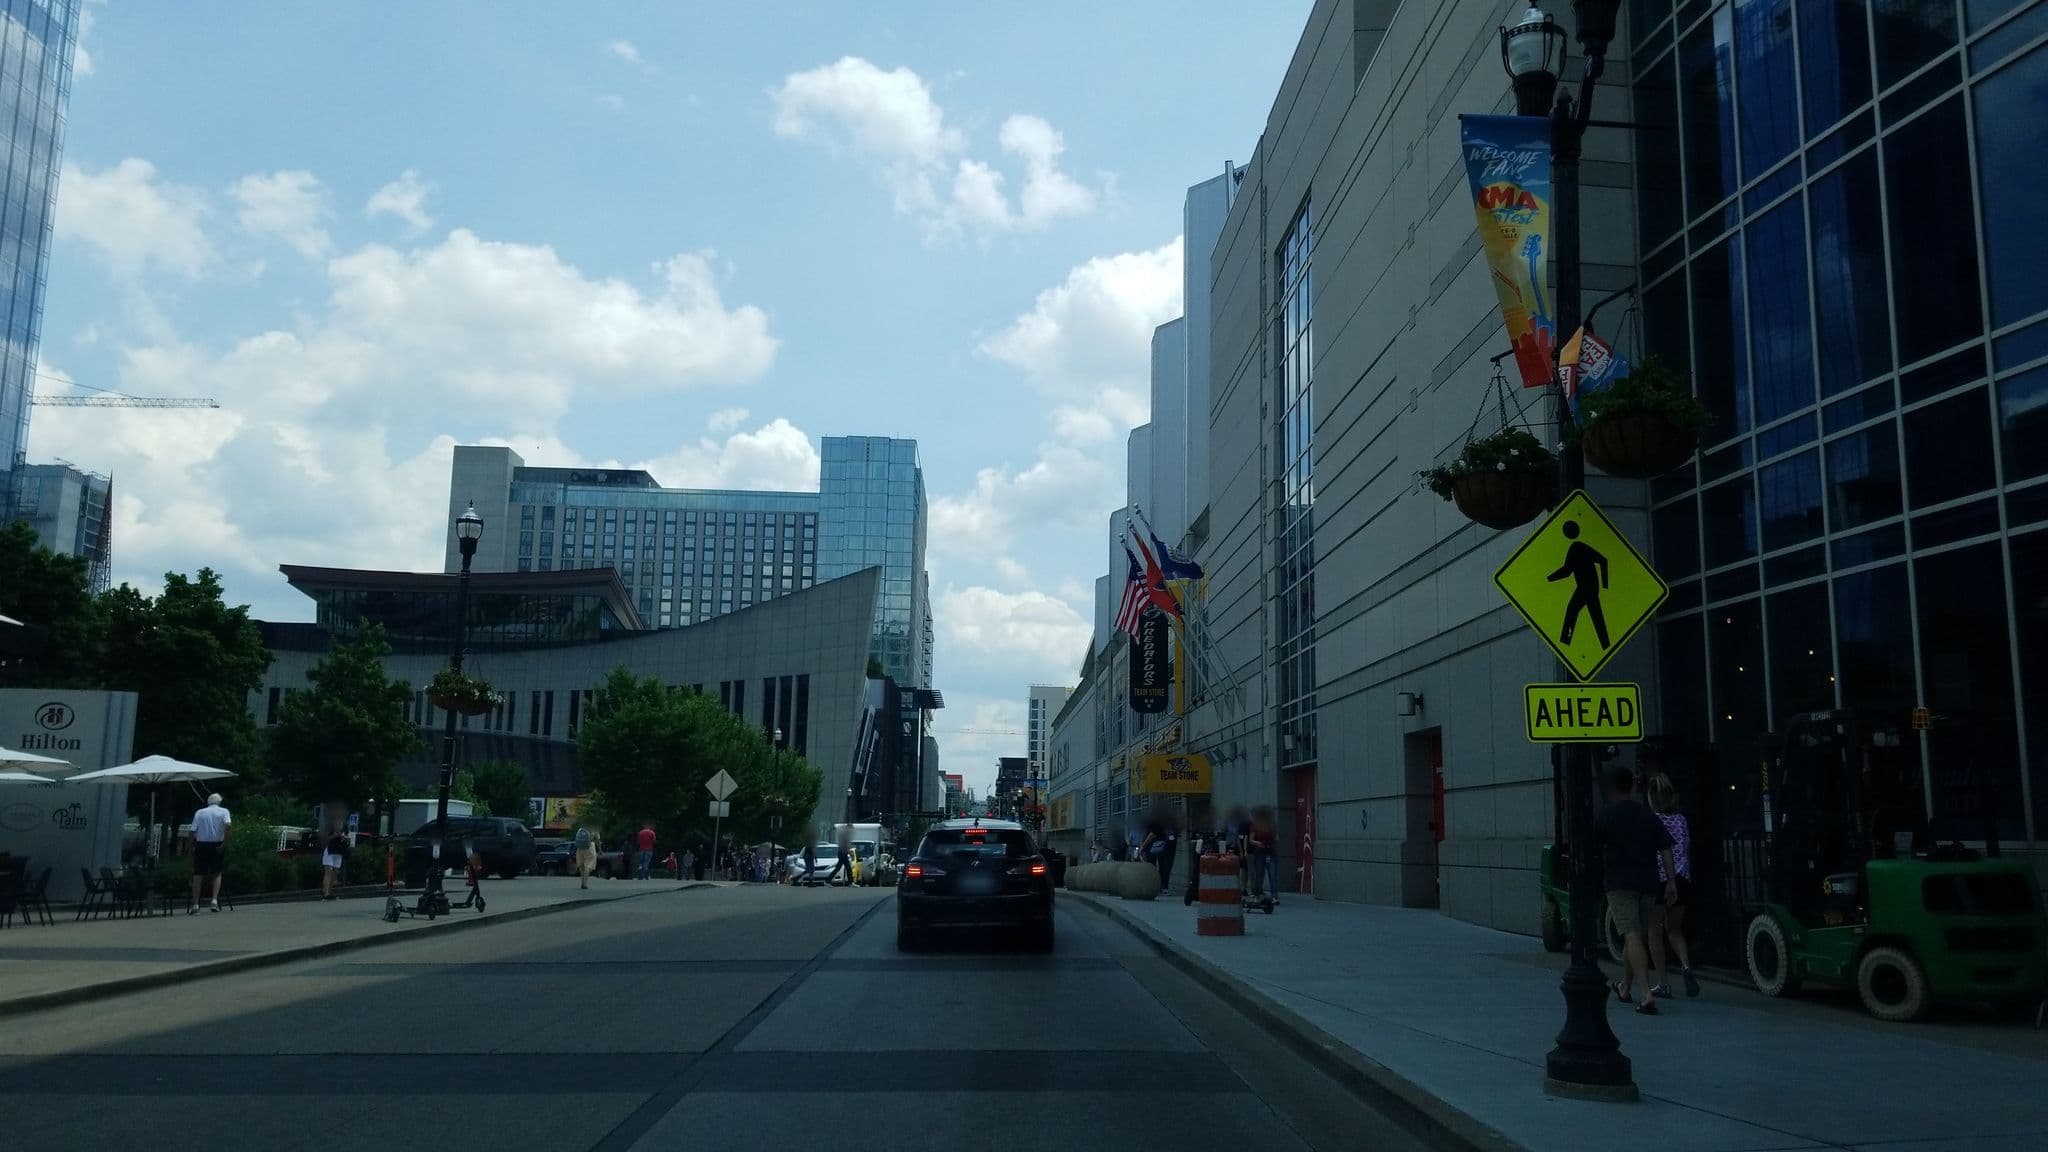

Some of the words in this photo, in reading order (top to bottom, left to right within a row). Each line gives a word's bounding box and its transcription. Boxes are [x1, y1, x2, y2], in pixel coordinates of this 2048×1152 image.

[1469, 147, 1544, 165] WELCOME
[1480, 159, 1531, 180] FANS
[1478, 186, 1539, 210] CMA
[1143, 621, 1155, 687] PREDATORS
[1535, 697, 1634, 728] AHEAD
[21, 733, 81, 751] Hilton
[1162, 769, 1178, 781] TEAM
[1180, 770, 1199, 782] STORE
[52, 803, 88, 827] Palm
